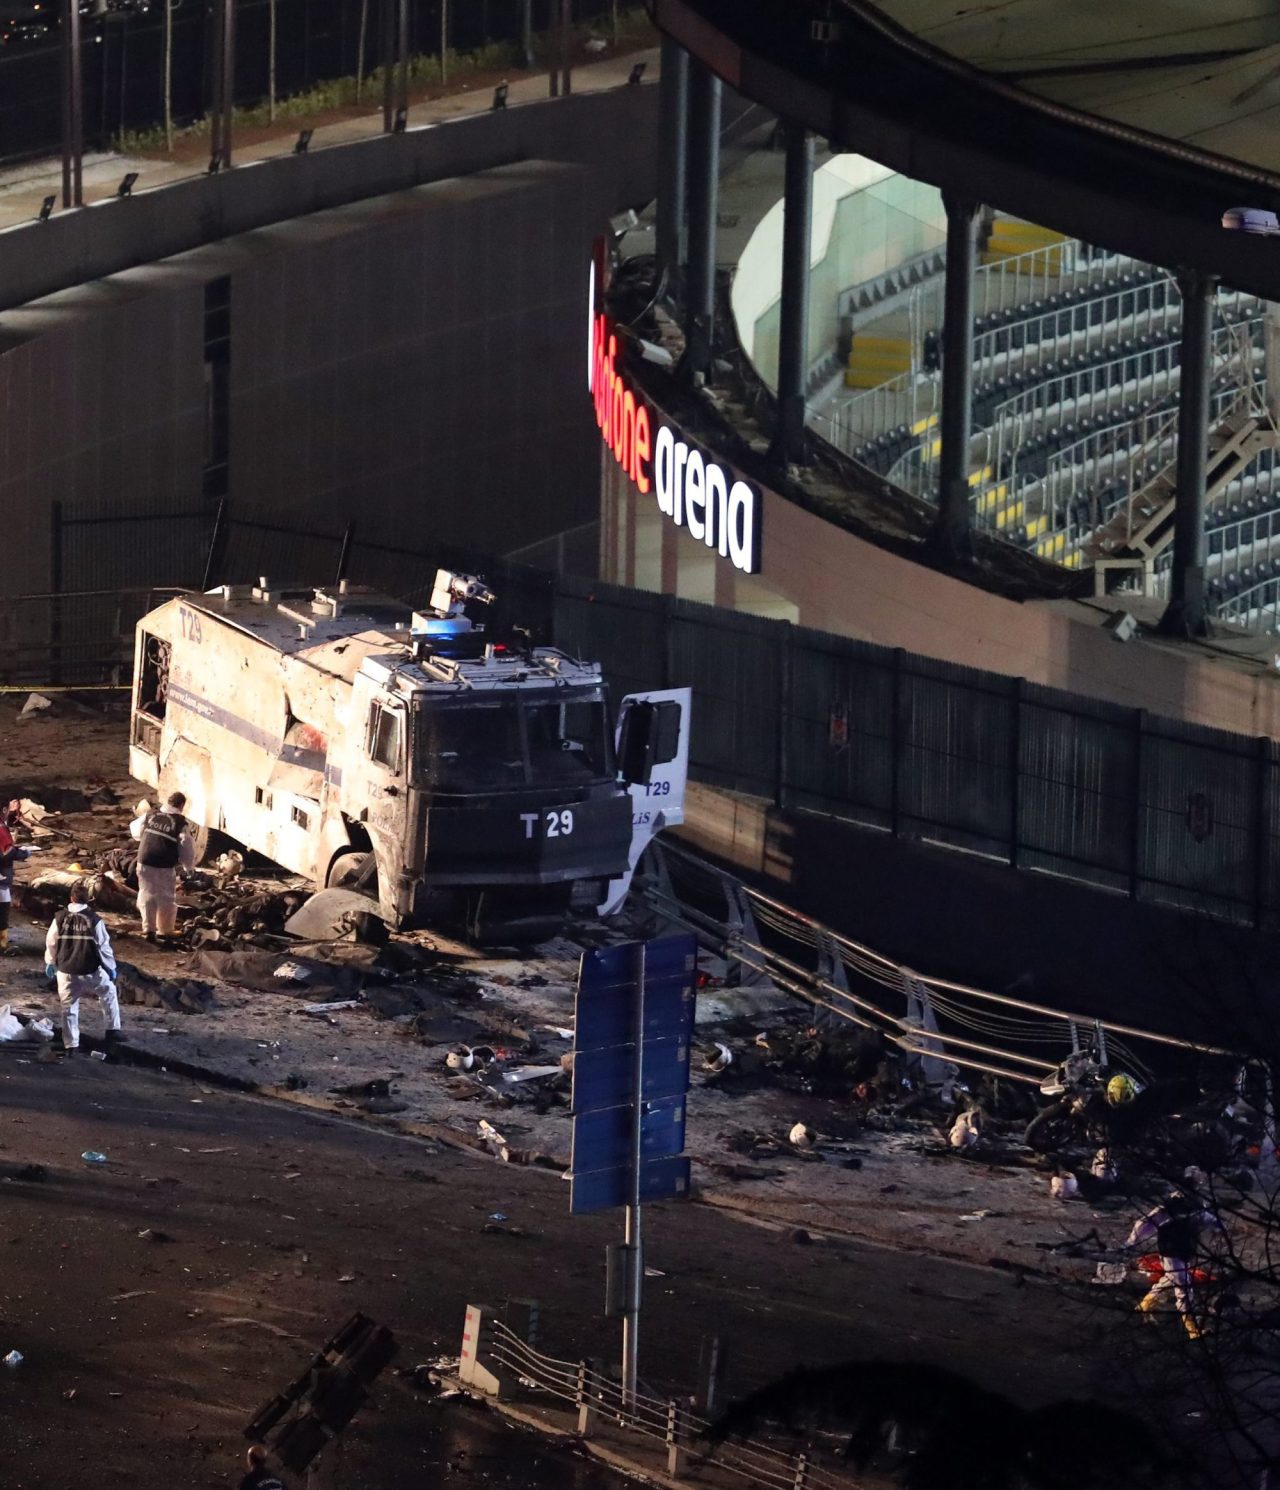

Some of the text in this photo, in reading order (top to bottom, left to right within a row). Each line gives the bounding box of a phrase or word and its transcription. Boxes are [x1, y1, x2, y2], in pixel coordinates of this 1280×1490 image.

[591, 313, 754, 574] dafone arena
[179, 606, 202, 645] T29
[644, 781, 670, 796] T29
